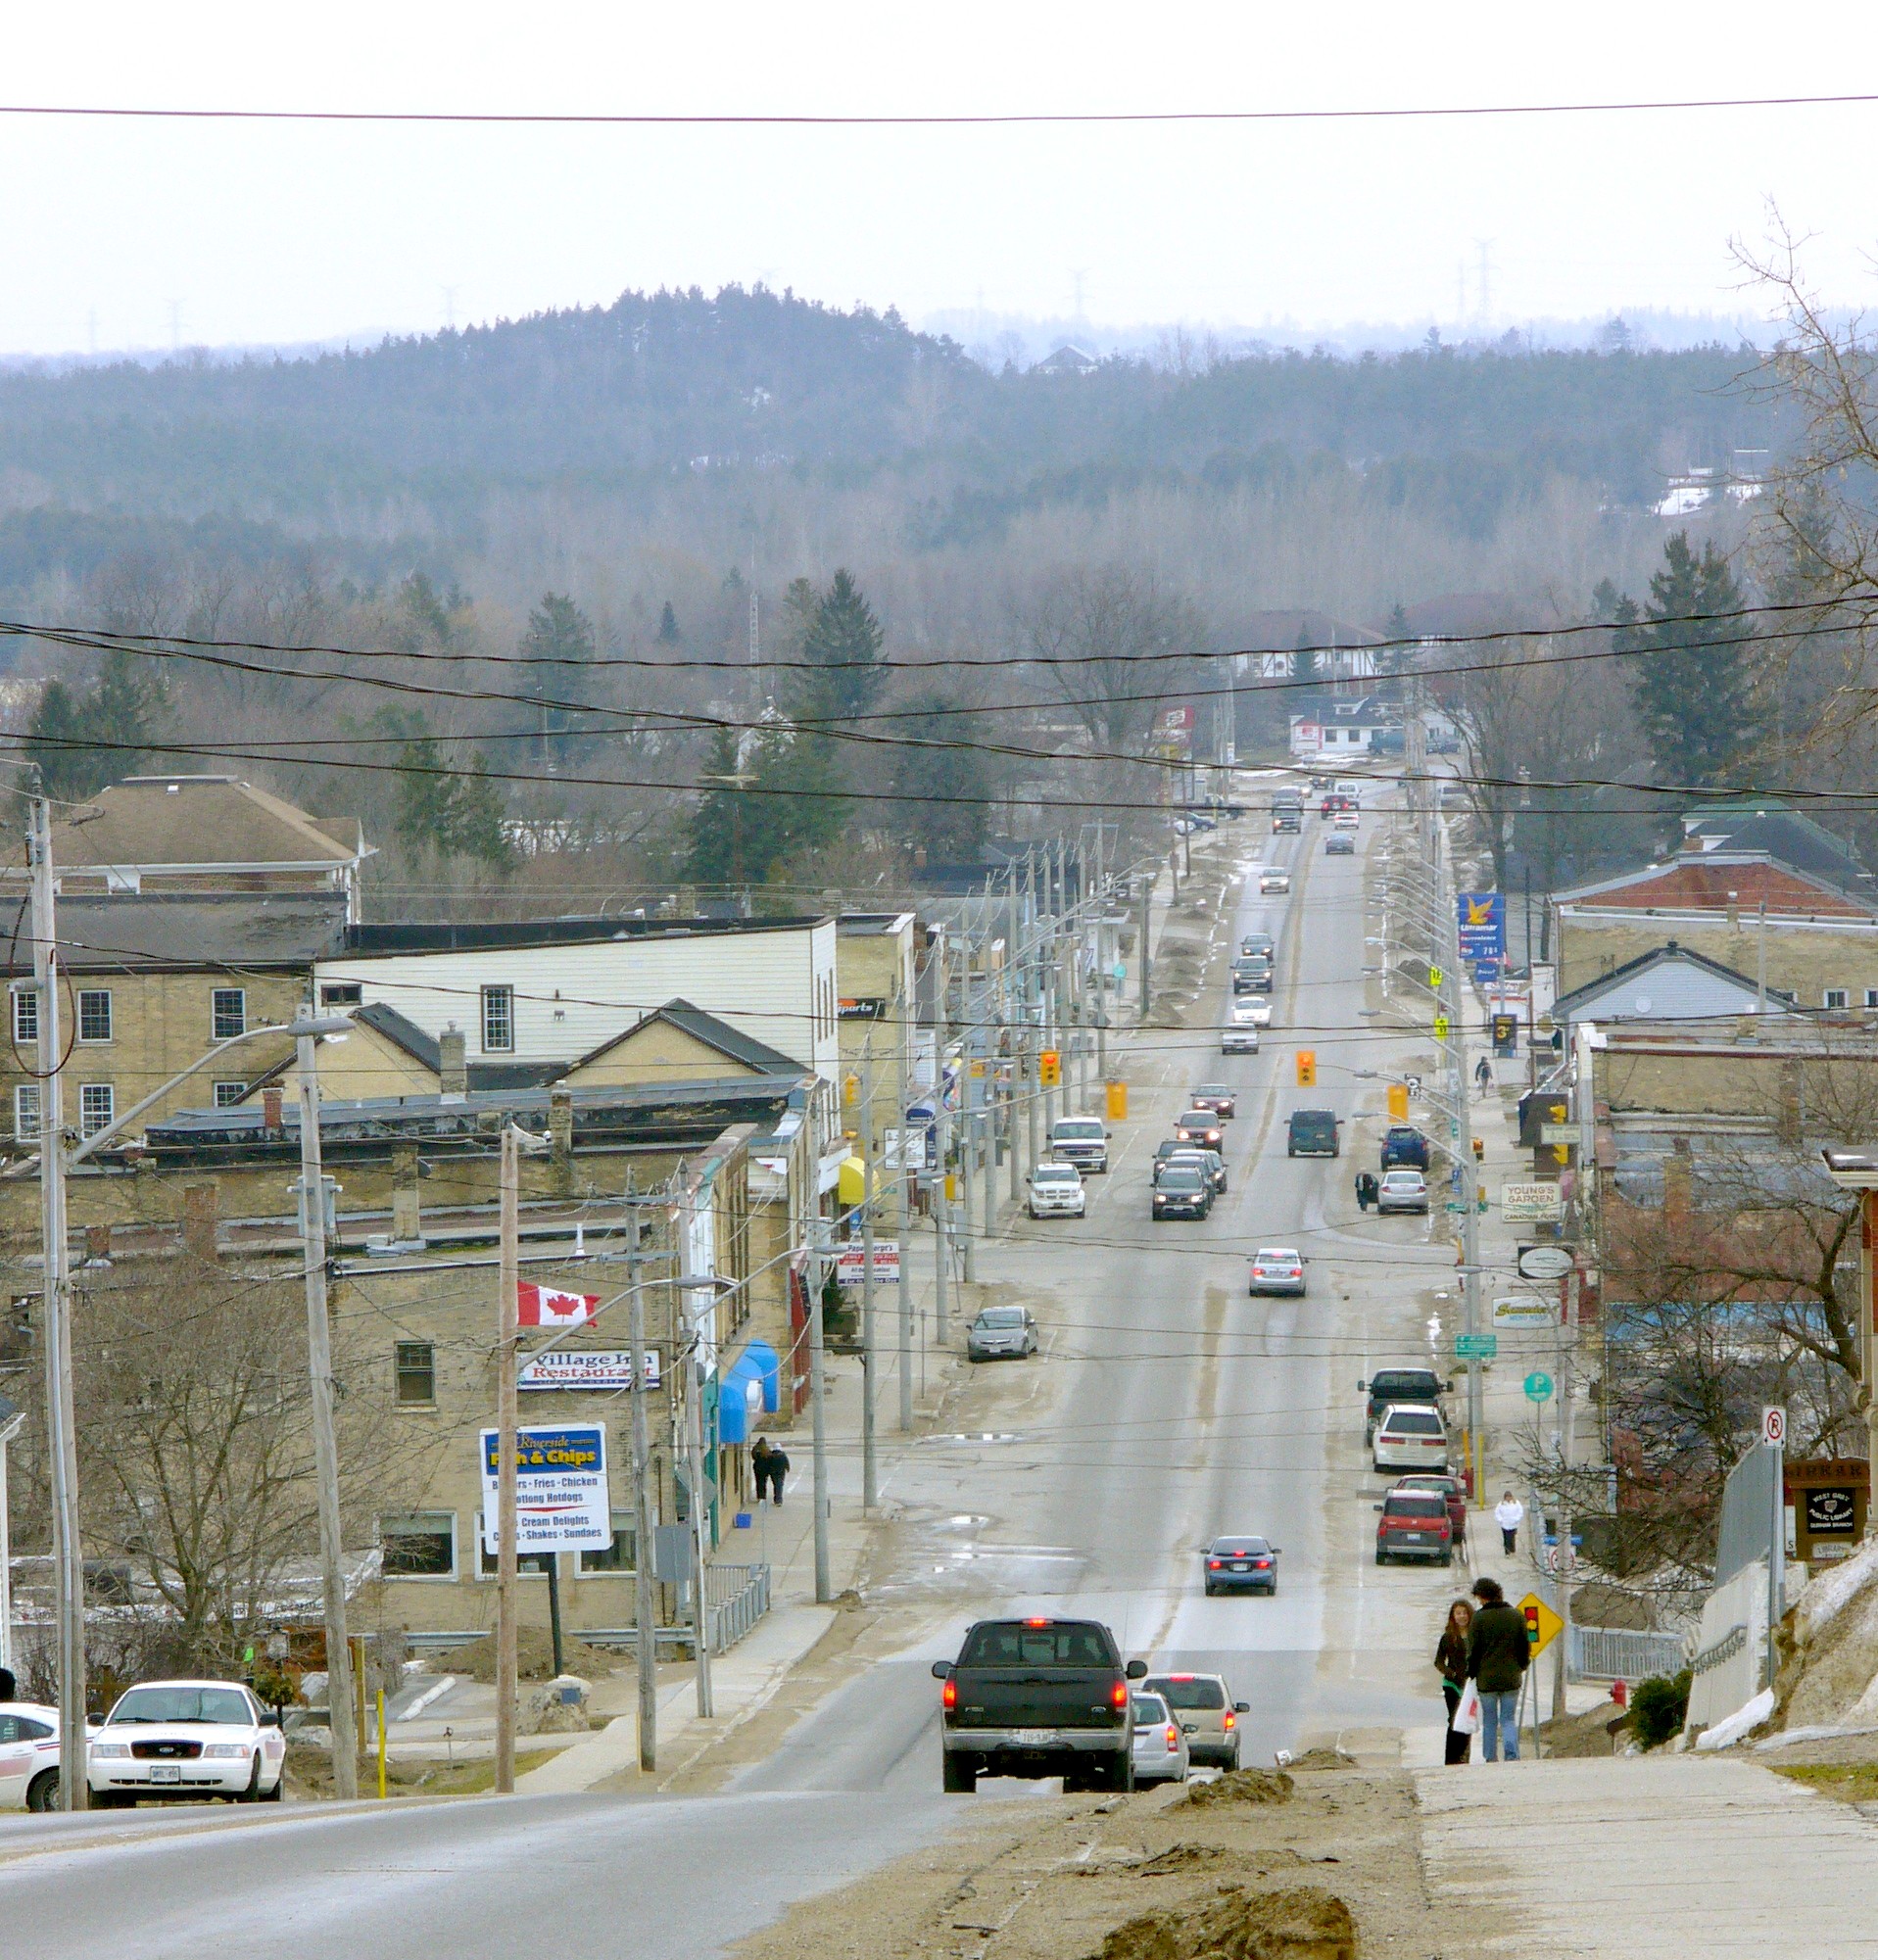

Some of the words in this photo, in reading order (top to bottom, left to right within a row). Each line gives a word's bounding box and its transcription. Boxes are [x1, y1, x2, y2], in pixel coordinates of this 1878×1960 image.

[1508, 1186, 1555, 1195] YOUNG'S
[535, 1354, 611, 1368] Village
[533, 1367, 653, 1378] Restaurat
[490, 1452, 527, 1465] Fh
[530, 1451, 544, 1464] &
[547, 1450, 596, 1466] Chips
[534, 1478, 555, 1488] Fries
[561, 1477, 598, 1487] Chicken
[516, 1494, 545, 1504] otlong
[547, 1493, 584, 1503] Hotdogs
[521, 1517, 551, 1527] Cream
[553, 1516, 590, 1526] Delights
[526, 1530, 557, 1540] Shakes
[563, 1528, 602, 1539] Sundaes
